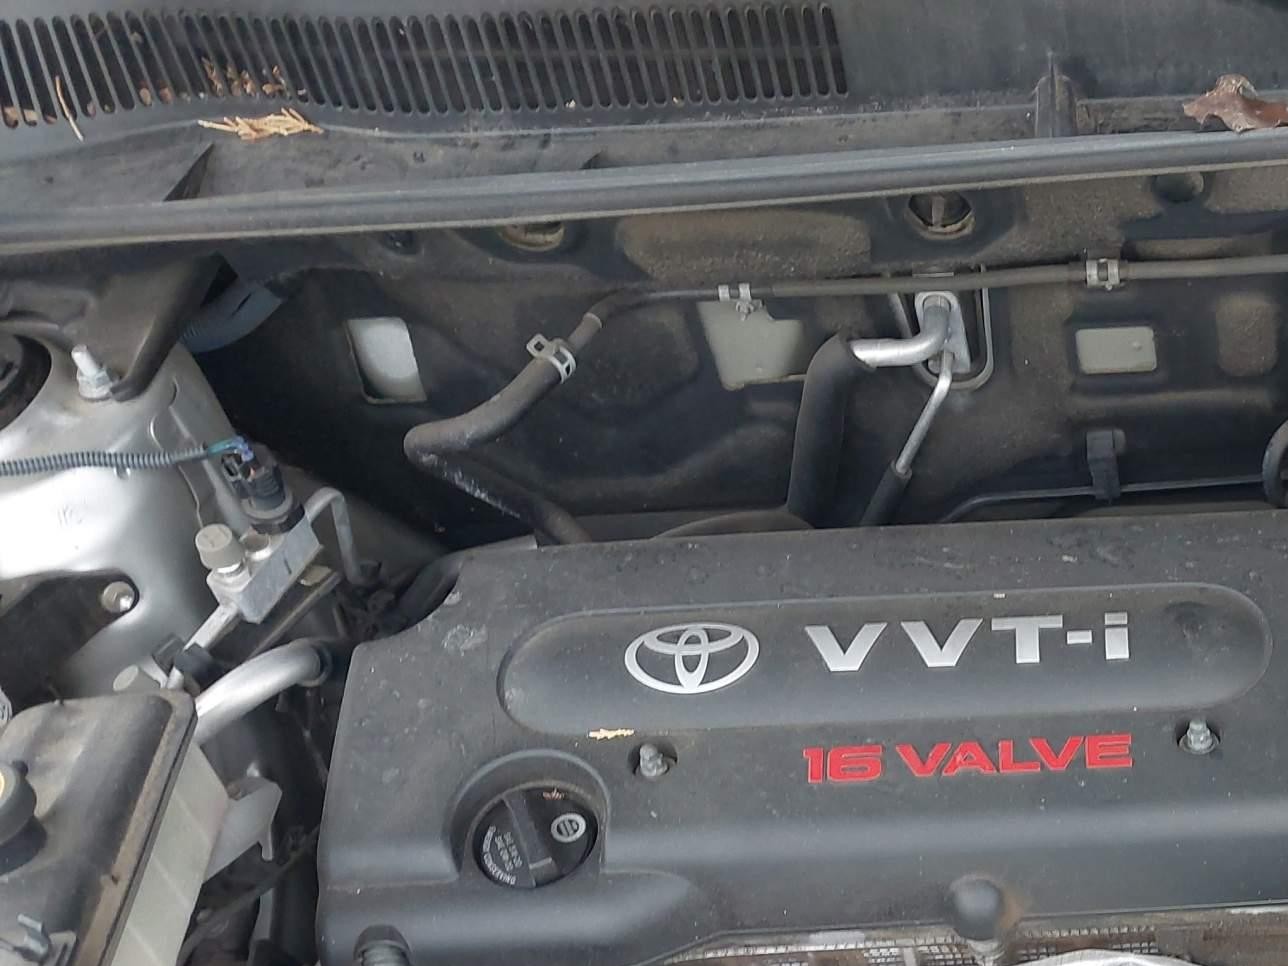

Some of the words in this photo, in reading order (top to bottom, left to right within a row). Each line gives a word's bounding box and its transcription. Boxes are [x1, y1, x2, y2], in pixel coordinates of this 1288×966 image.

[804, 612, 1130, 672] VVT-i
[803, 745, 887, 784] 16
[895, 734, 1133, 778] VALVE
